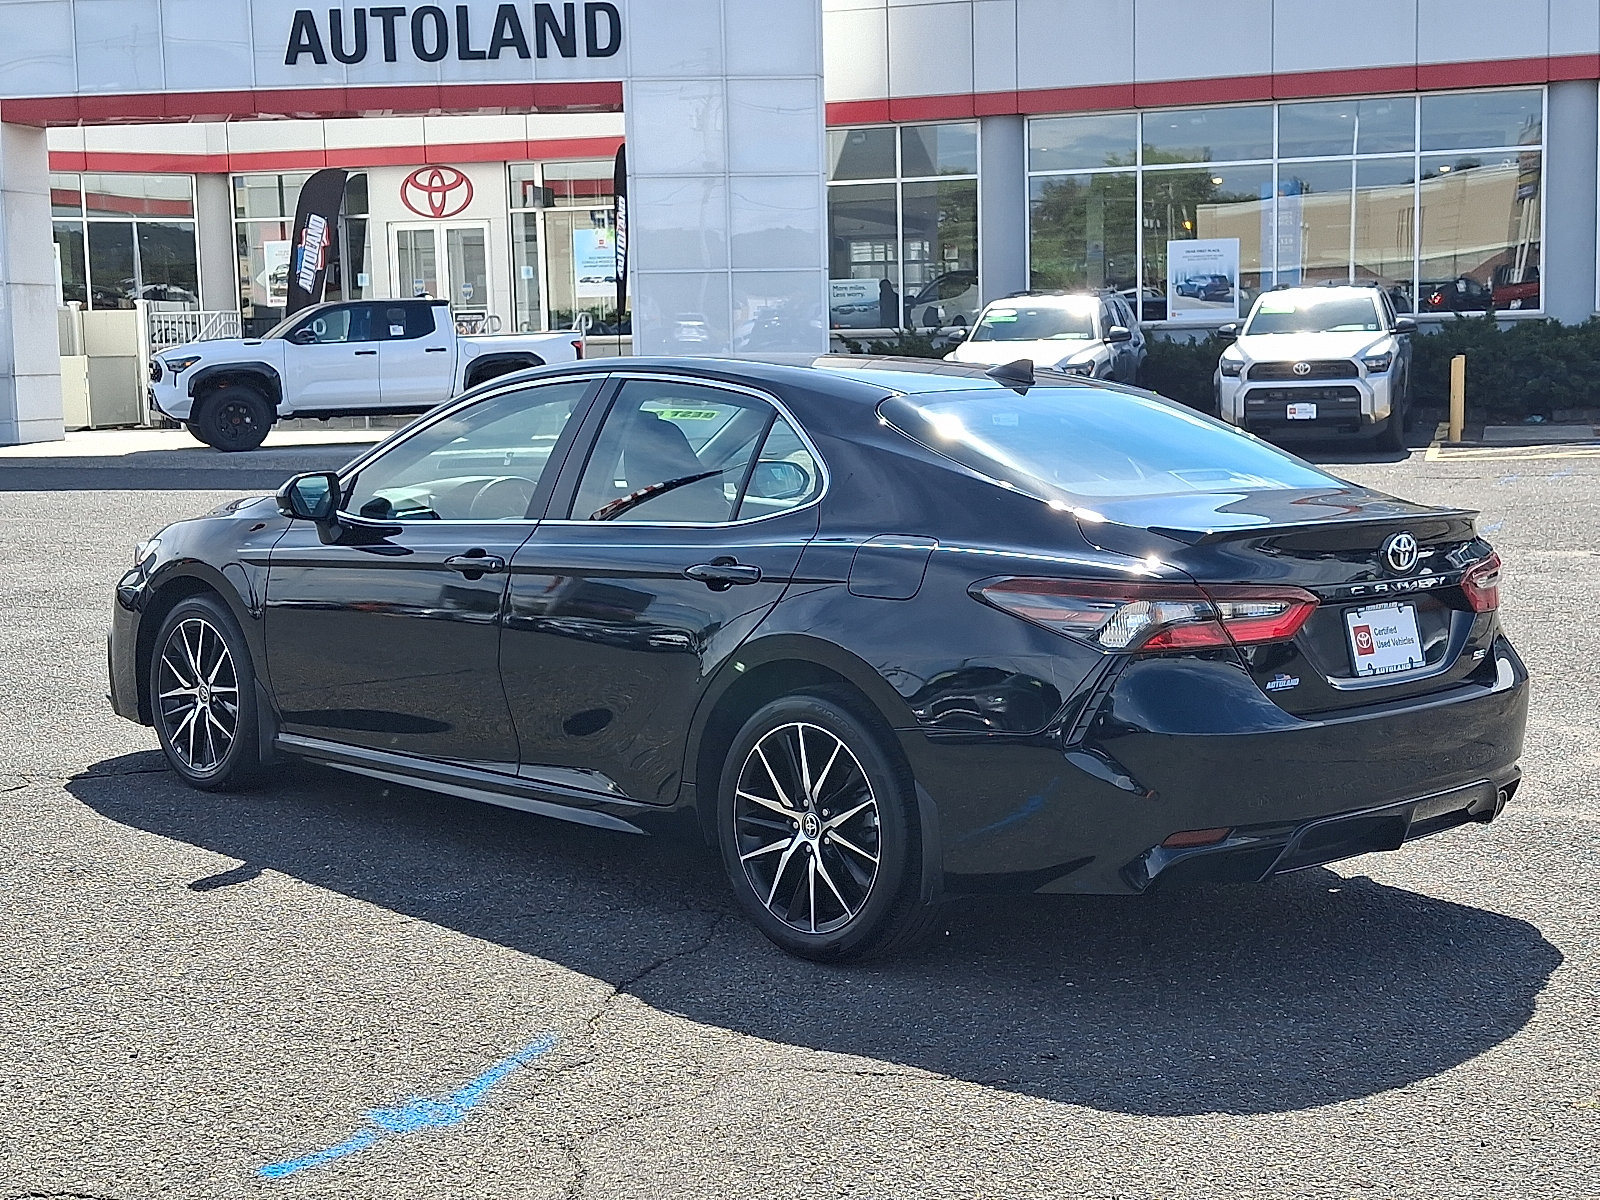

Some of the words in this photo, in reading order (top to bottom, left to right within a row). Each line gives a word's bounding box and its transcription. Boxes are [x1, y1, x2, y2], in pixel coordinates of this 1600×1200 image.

[285, 2, 621, 65] AUTOLAND
[298, 213, 326, 295] AUTOLAND
[1374, 625, 1398, 636] Certified
[1376, 640, 1391, 649] Used
[1392, 636, 1415, 647] Vehicles
[1375, 662, 1411, 675] AUTOLAND
[1266, 677, 1300, 689] AUTOLAND
